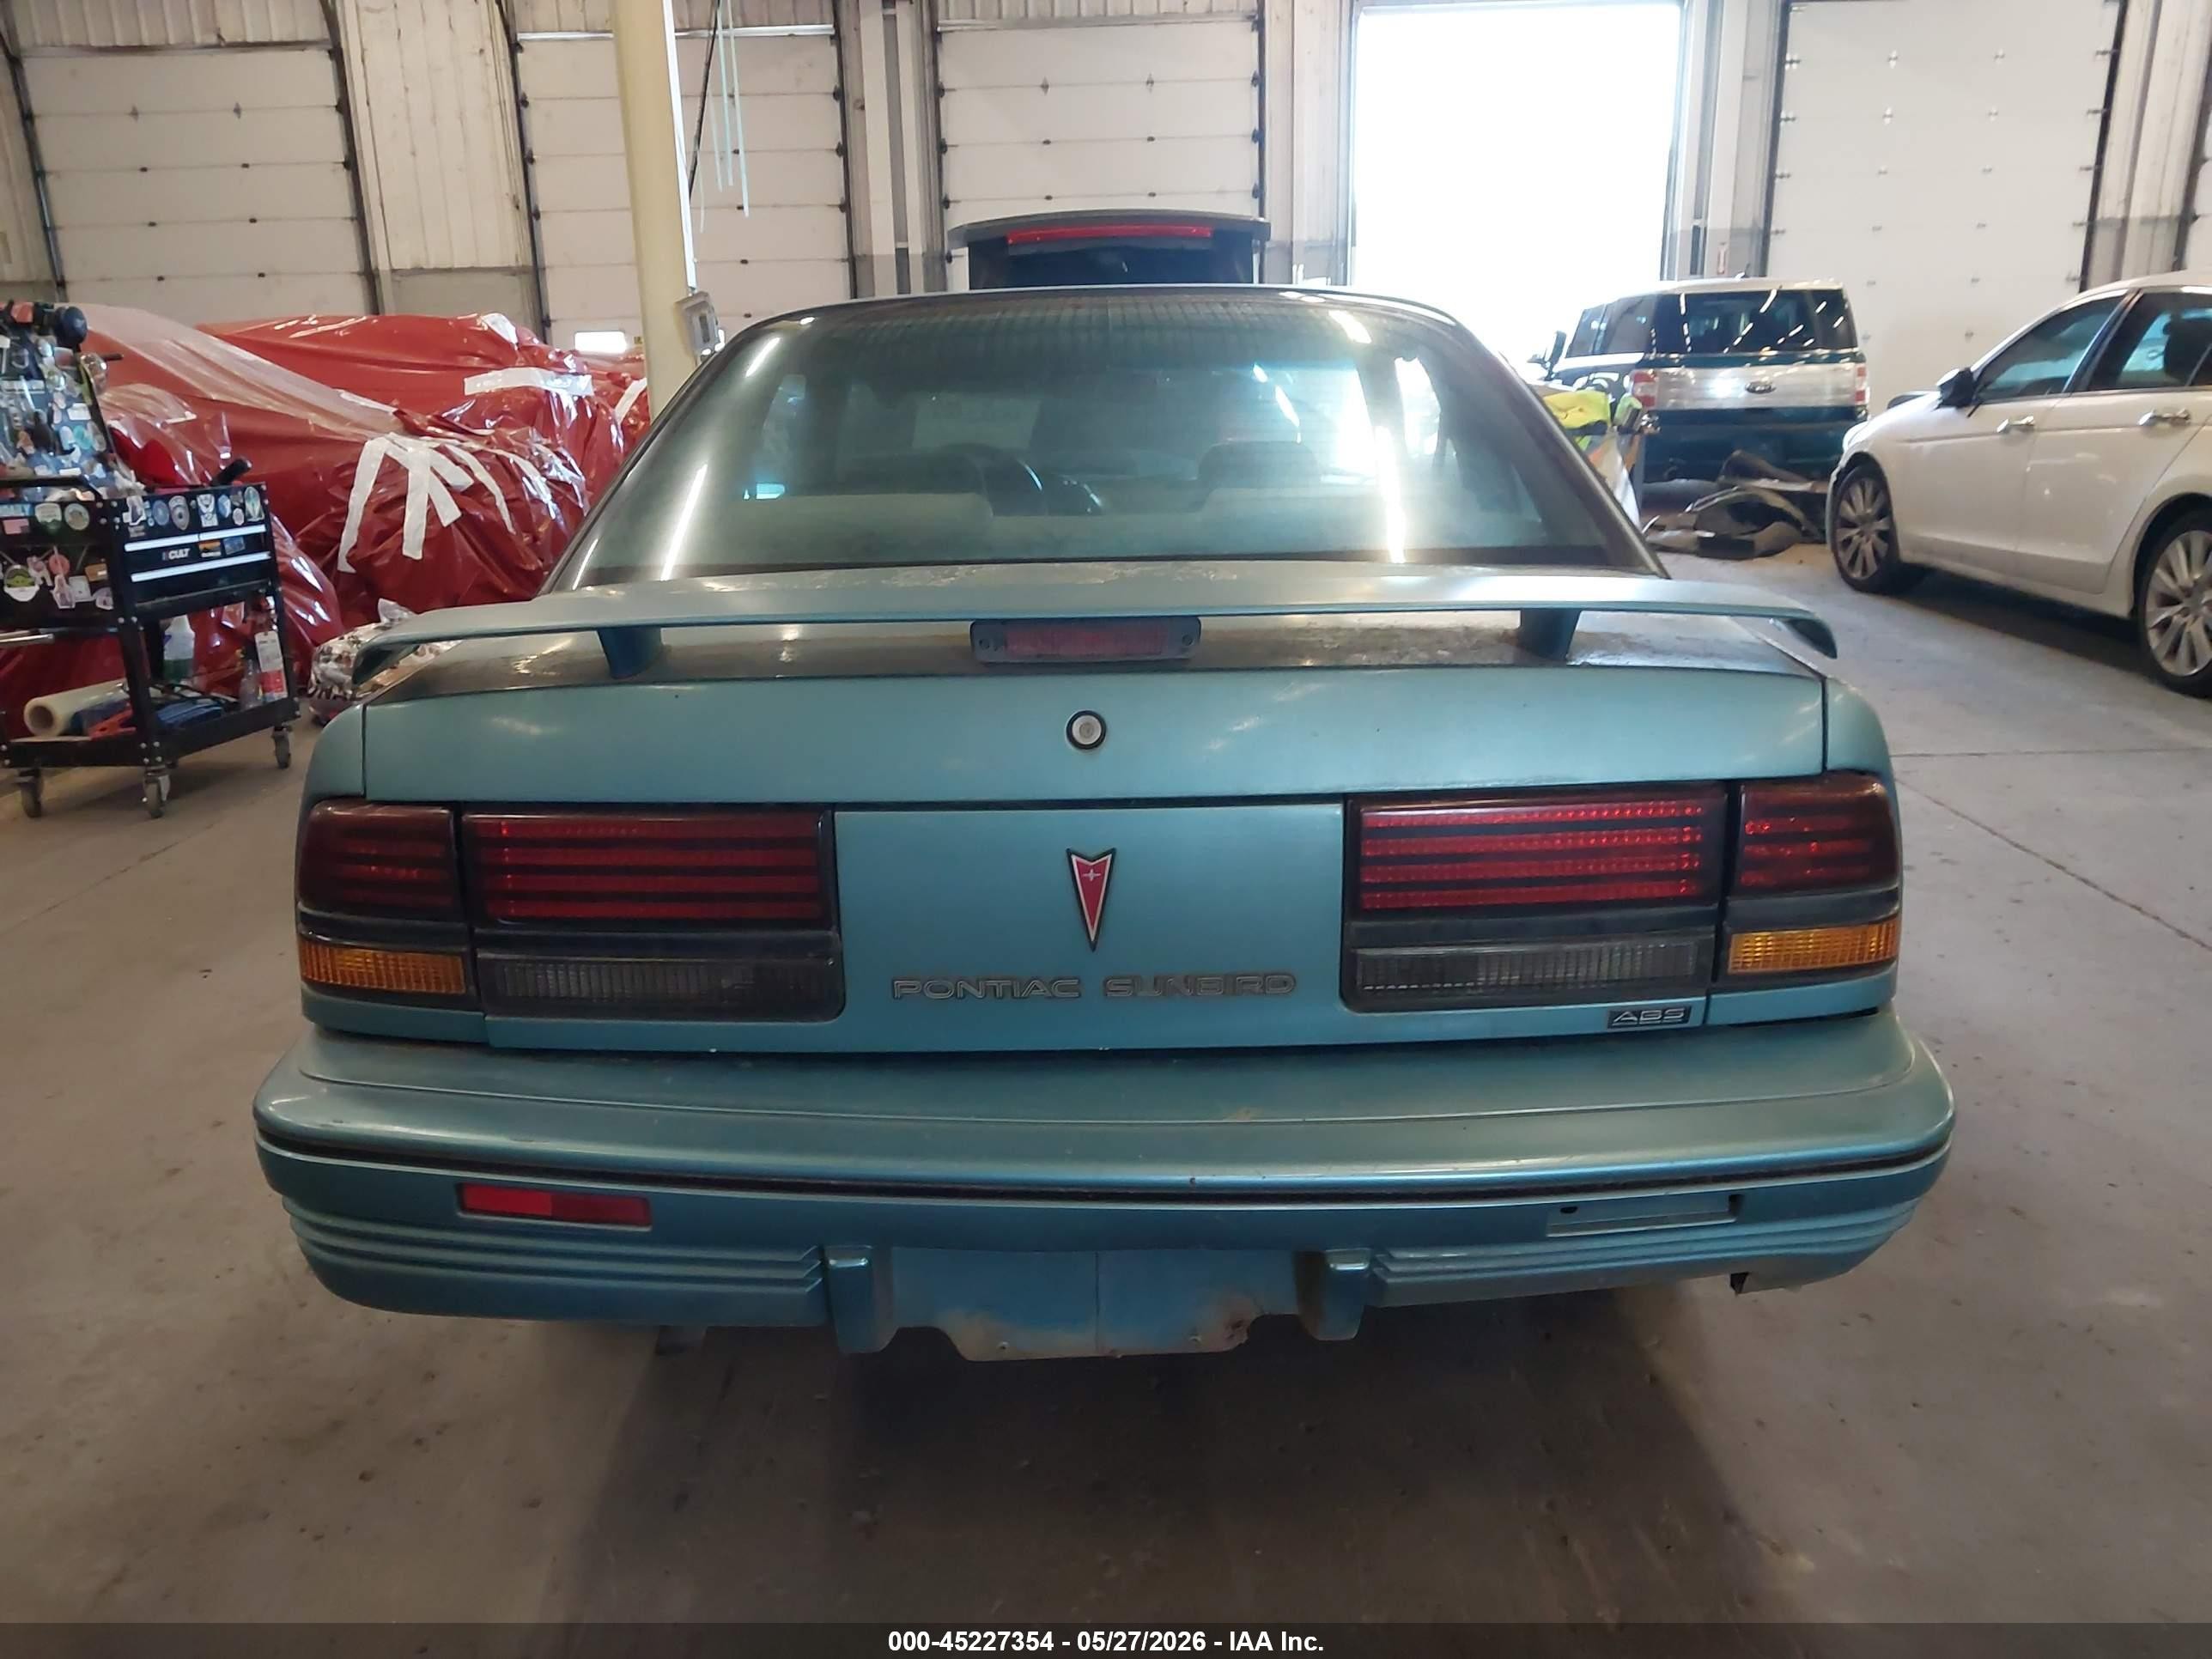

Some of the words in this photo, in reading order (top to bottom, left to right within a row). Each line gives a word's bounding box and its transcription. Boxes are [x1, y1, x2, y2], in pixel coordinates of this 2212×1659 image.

[892, 977, 1080, 1000] PONTIAC
[1103, 973, 1297, 999] SUNBIRD
[1613, 1007, 1686, 1025] ABS
